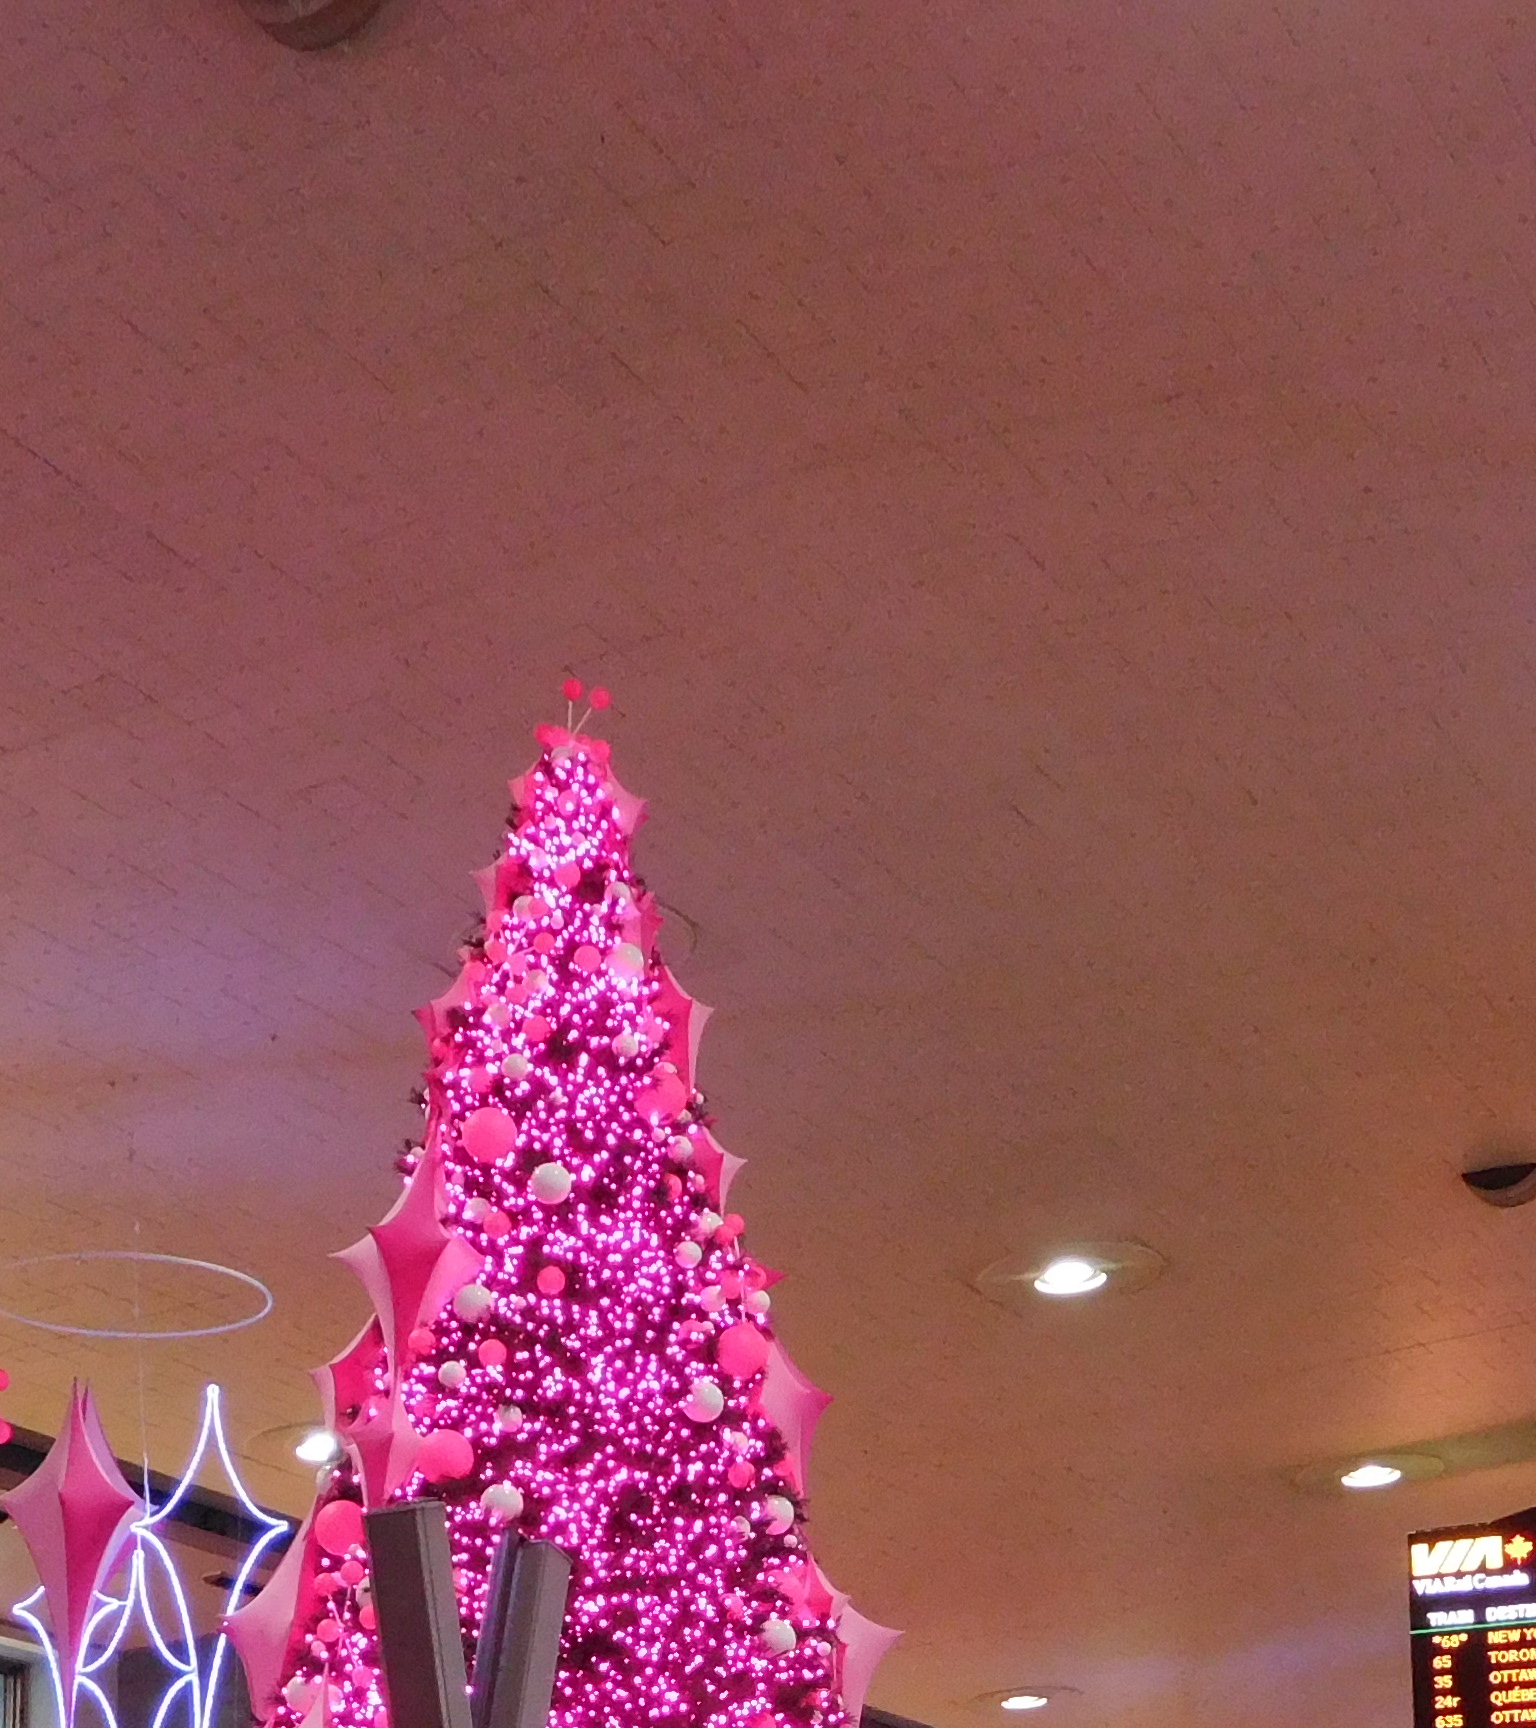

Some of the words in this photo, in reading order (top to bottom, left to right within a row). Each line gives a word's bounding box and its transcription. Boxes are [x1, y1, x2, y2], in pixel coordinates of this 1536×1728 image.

[1411, 1536, 1504, 1577] VIA
[1487, 1627, 1523, 1645] NEW
[1432, 1655, 1453, 1670] 65
[1434, 1675, 1453, 1690] 35
[1434, 1695, 1462, 1710] 24r
